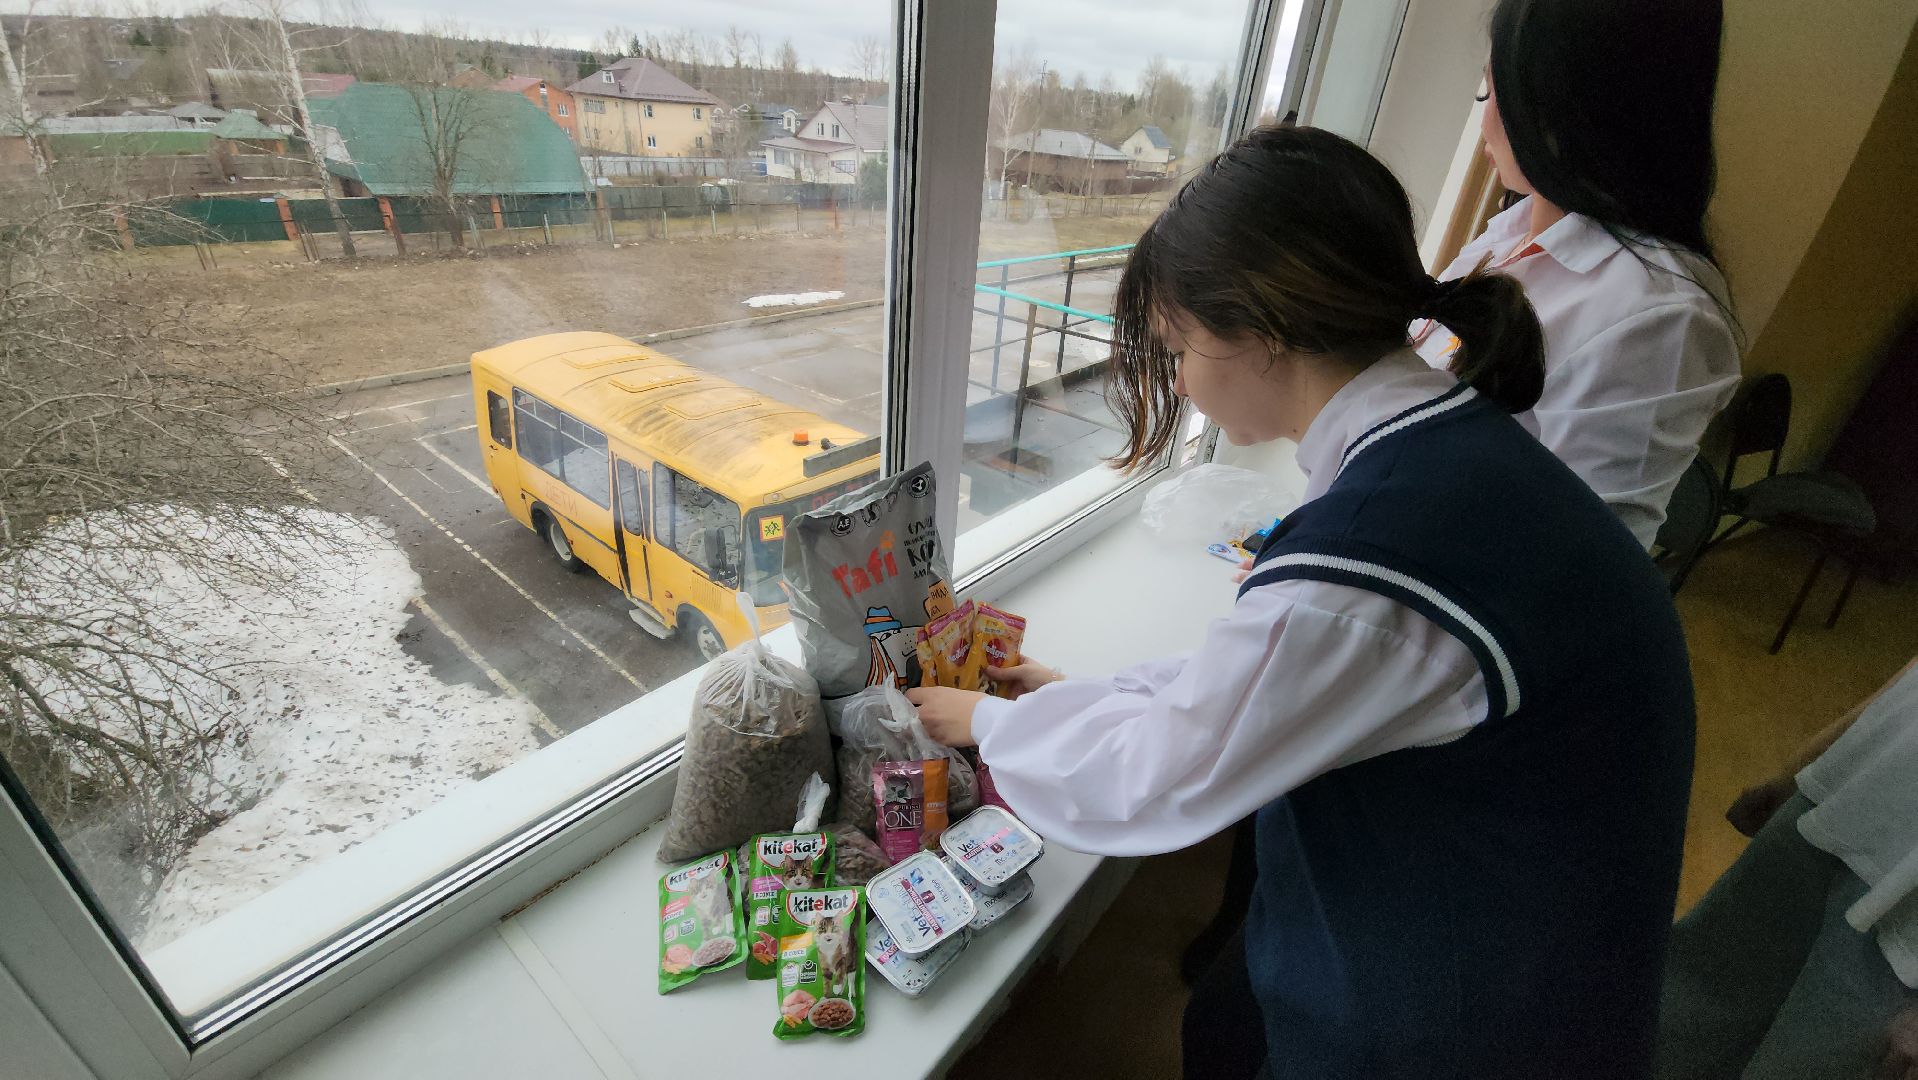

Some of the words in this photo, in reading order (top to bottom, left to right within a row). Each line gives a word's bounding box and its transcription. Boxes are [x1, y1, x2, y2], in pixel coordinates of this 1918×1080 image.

[885, 810, 921, 827] ONE
[763, 838, 818, 856] kitekat
[794, 894, 849, 912] kitekat
